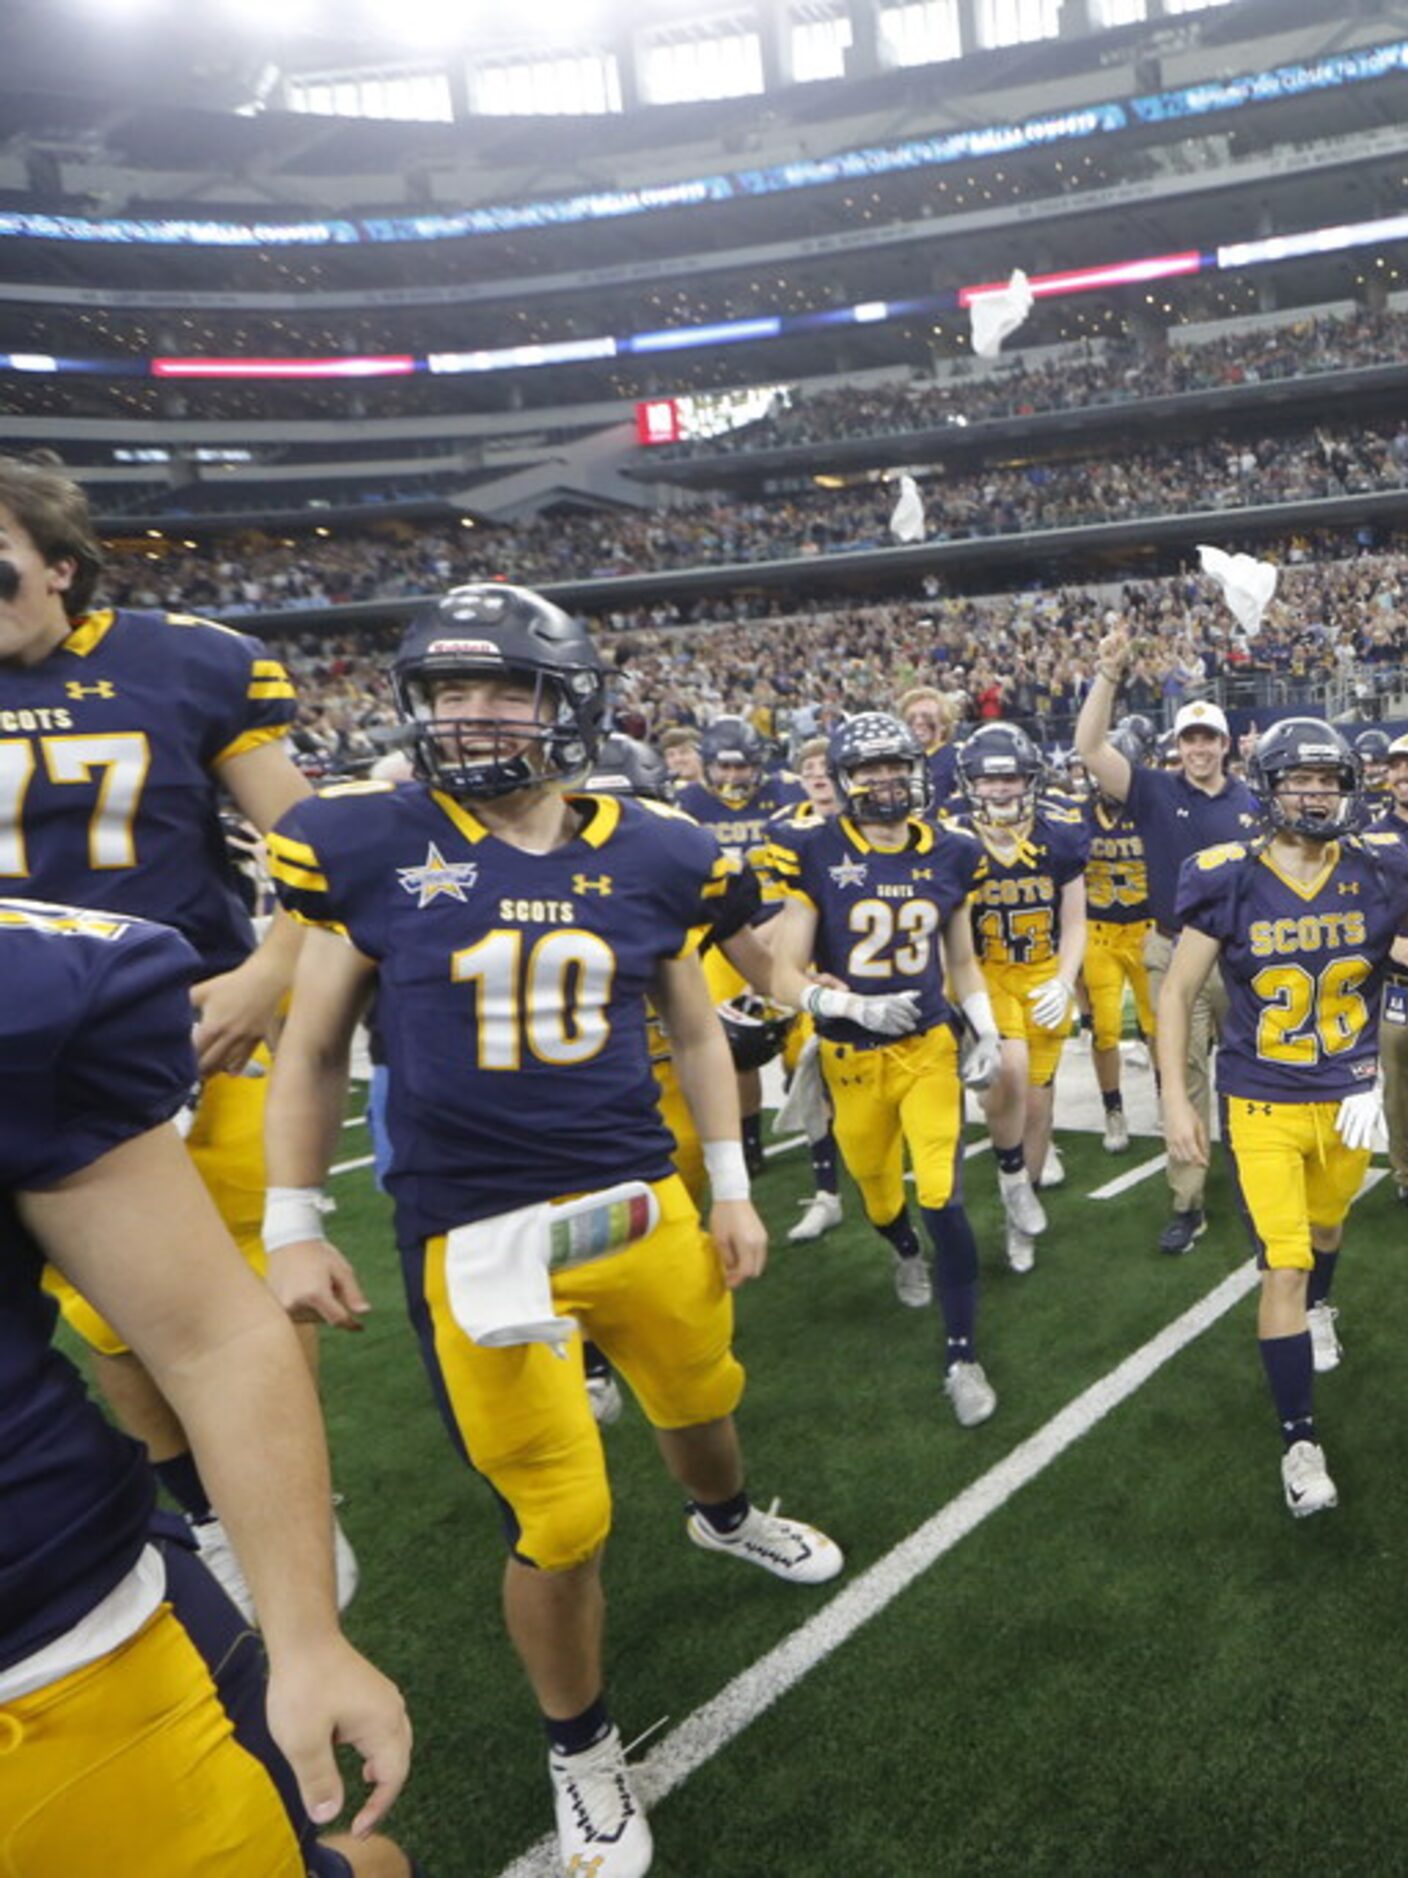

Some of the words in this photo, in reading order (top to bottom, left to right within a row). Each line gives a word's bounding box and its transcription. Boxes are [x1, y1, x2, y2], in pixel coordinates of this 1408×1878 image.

[0, 708, 74, 731] COTS
[1091, 836, 1143, 858] COTS
[500, 898, 575, 923] SCOTS
[848, 898, 939, 978] 23
[1250, 911, 1366, 957] SCOTS
[451, 928, 617, 1071] 10
[1250, 954, 1373, 1066] 26
